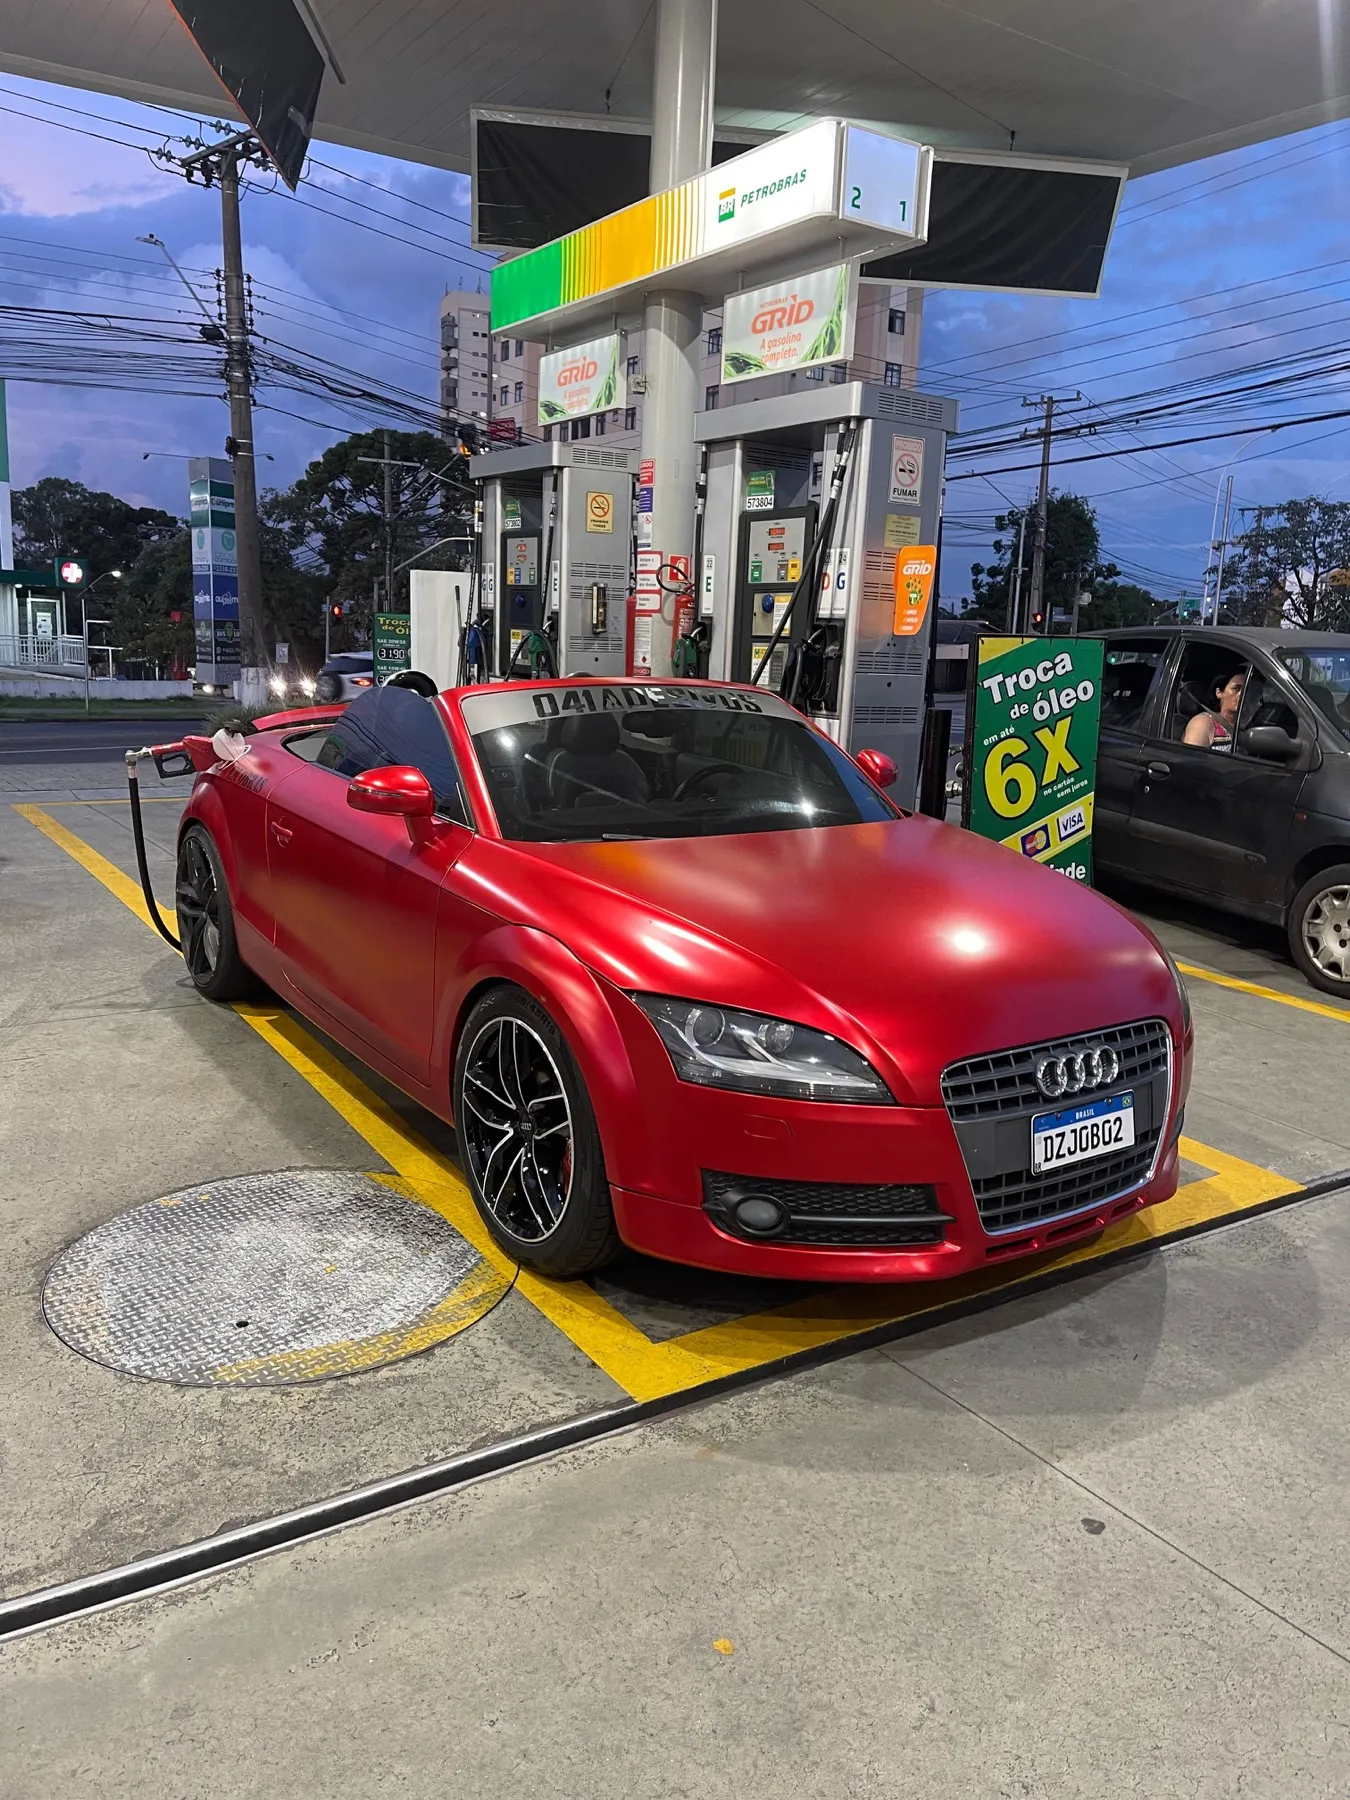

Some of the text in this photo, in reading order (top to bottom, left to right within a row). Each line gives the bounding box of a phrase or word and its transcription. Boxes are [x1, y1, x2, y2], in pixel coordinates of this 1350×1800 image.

[740, 169, 807, 207] PETROBRAS
[851, 186, 906, 221] 2 1
[751, 294, 814, 334] GRID
[767, 332, 802, 352] gasolina
[557, 356, 598, 387] GRID
[747, 496, 773, 508] 573804
[893, 487, 918, 498] FUMAR
[903, 560, 931, 575] GRID
[706, 576, 712, 592] E
[836, 572, 846, 590] G
[983, 652, 1073, 704] Troca
[1010, 680, 1094, 721] de óleo
[983, 725, 1016, 746] em até
[1043, 777, 1075, 796] no cartão
[1057, 779, 1088, 798] sem juros
[1062, 812, 1083, 832] VISA
[1076, 1108, 1095, 1119] BRASIL
[1043, 1116, 1124, 1163] DZJ0B02
